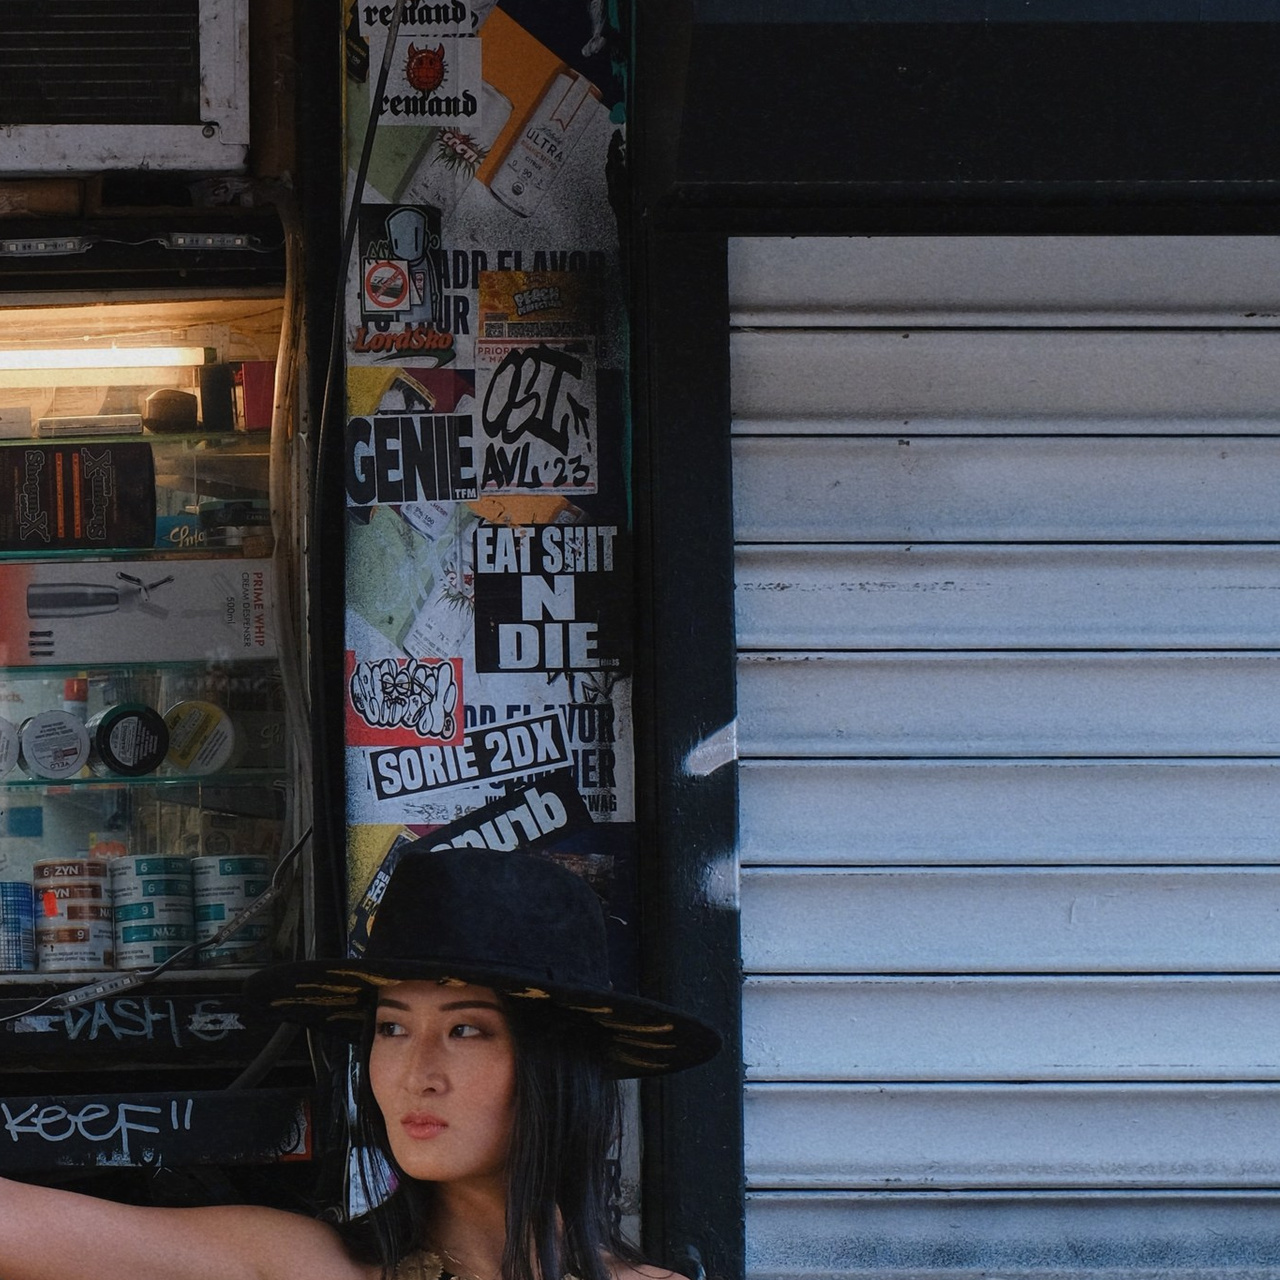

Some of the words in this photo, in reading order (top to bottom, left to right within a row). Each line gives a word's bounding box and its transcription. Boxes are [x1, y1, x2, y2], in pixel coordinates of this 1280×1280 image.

[377, 89, 478, 118] remand
[526, 128, 564, 162] ULTRA
[347, 415, 477, 505] GENIE
[455, 488, 477, 500] TFM
[477, 525, 535, 574] EAT
[542, 525, 618, 574] SHIT
[241, 571, 249, 597] CREAM
[252, 571, 263, 611] PRIME
[521, 574, 576, 621] N
[254, 614, 265, 647] WHIP
[498, 622, 600, 670] DIE
[484, 719, 561, 773] 2DX
[54, 865, 79, 876] ZYN
